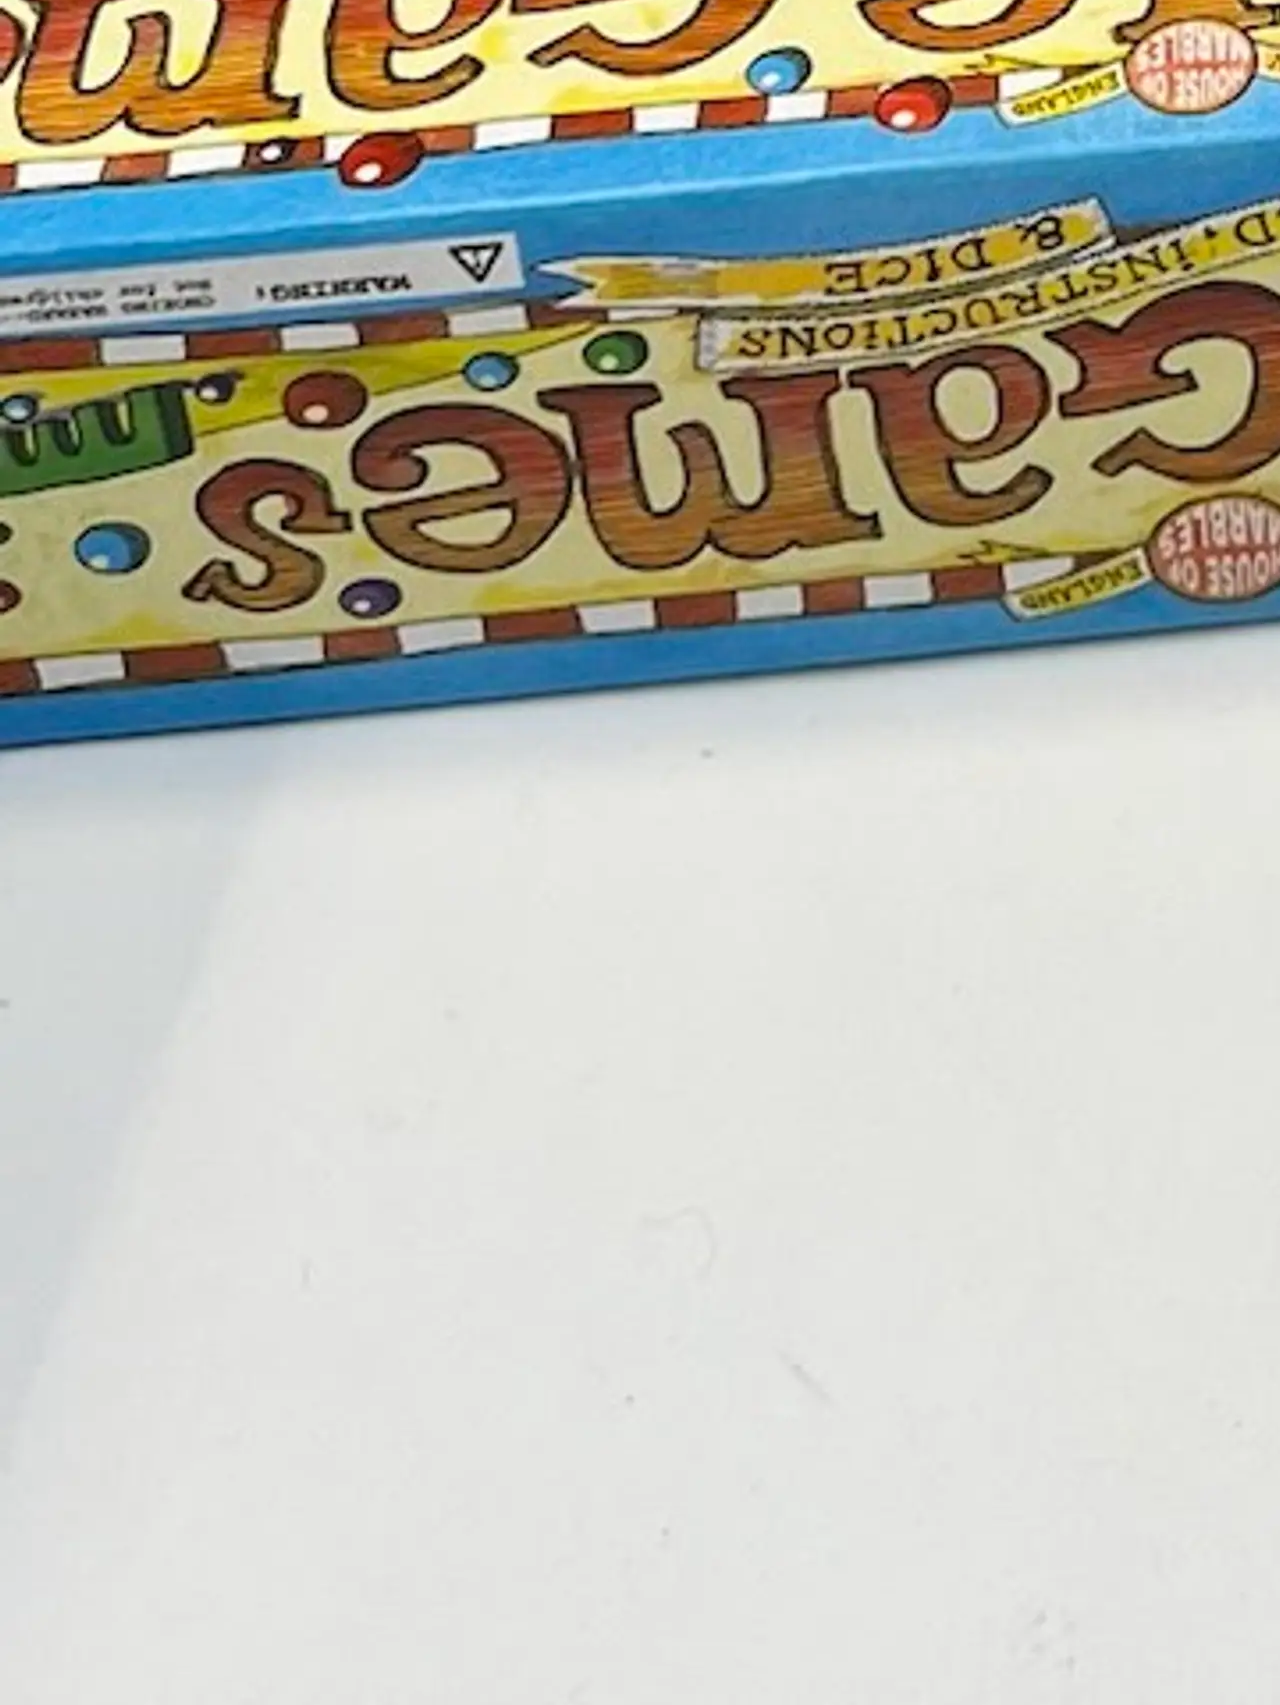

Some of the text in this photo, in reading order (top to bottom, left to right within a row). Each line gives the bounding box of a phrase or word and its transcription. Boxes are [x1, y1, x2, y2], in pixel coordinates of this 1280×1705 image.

[1019, 214, 1065, 250] &
[1019, 561, 1142, 610] ENGLAND
[1165, 557, 1198, 587] OF
